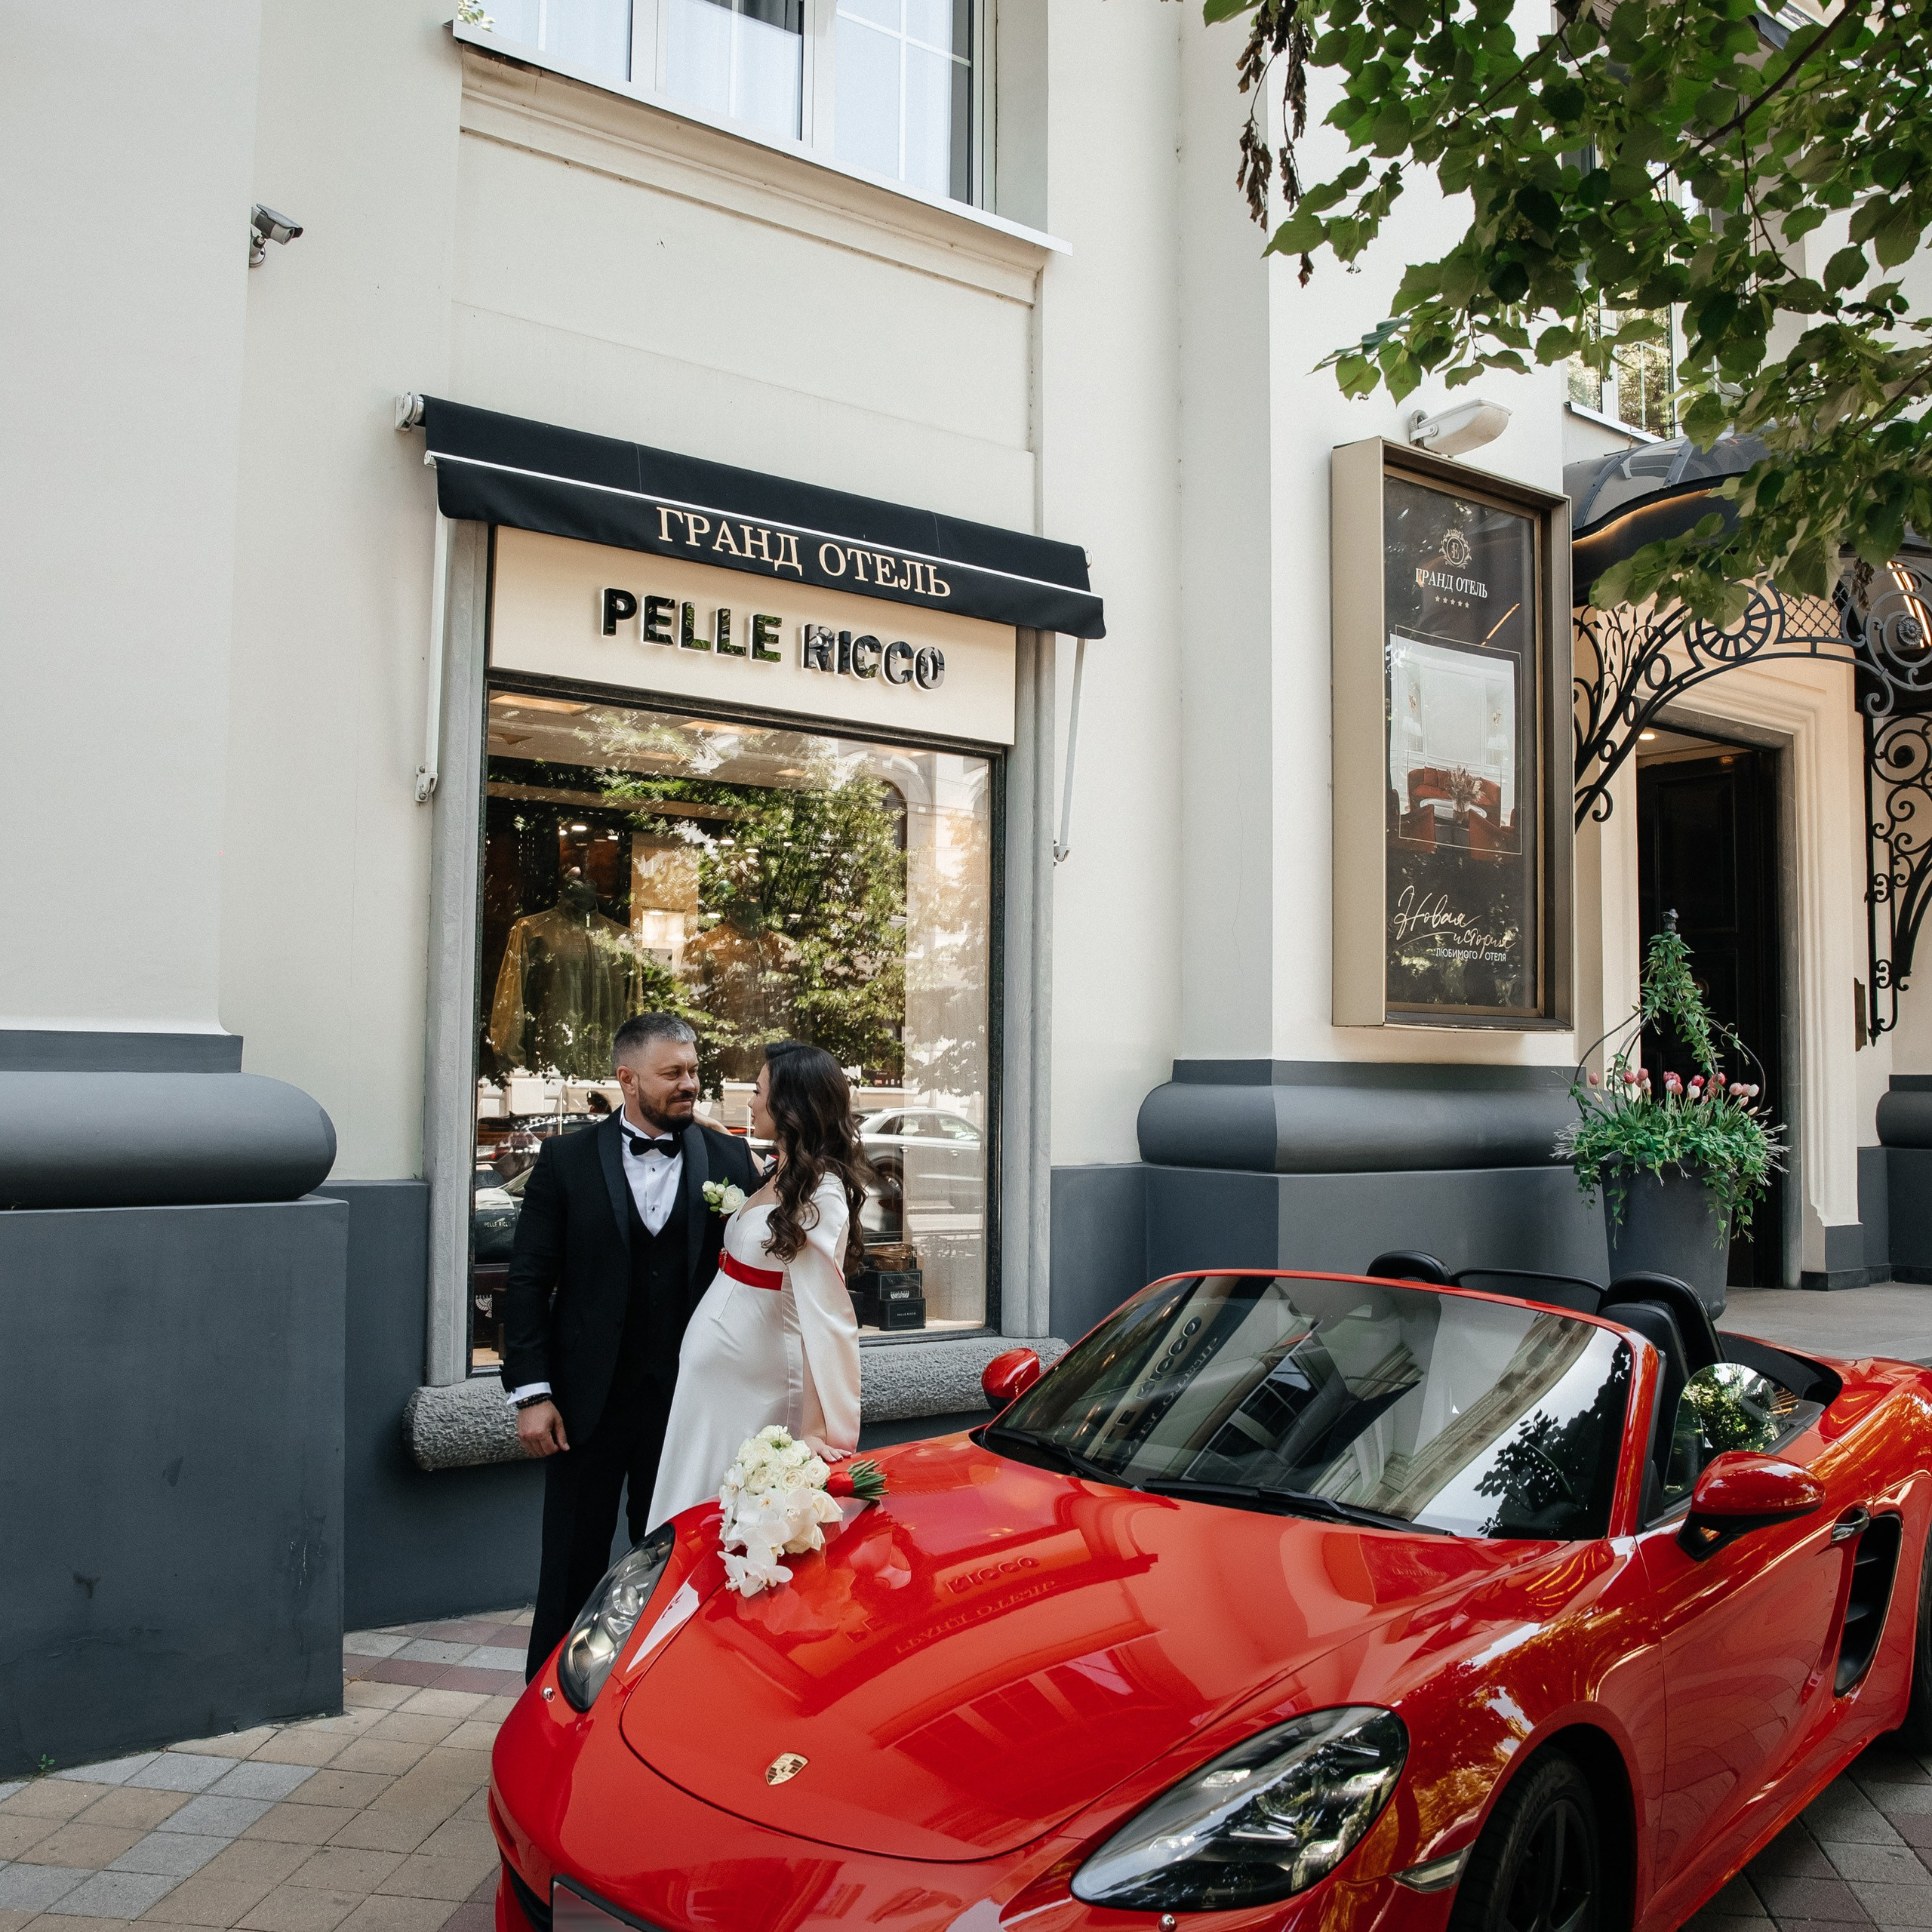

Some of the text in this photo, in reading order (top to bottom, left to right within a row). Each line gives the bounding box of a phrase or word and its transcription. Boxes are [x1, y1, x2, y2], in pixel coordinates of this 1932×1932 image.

[656, 506, 952, 598] ГРАНД ОТЕЛЬ
[1415, 568, 1487, 598] ГРАНД ОТЕЛЬ
[602, 587, 946, 691] PELLE RICCO
[1394, 885, 1482, 940] Новая
[1435, 947, 1506, 962] ЛЮБИМОГО ОТЕЛЯ
